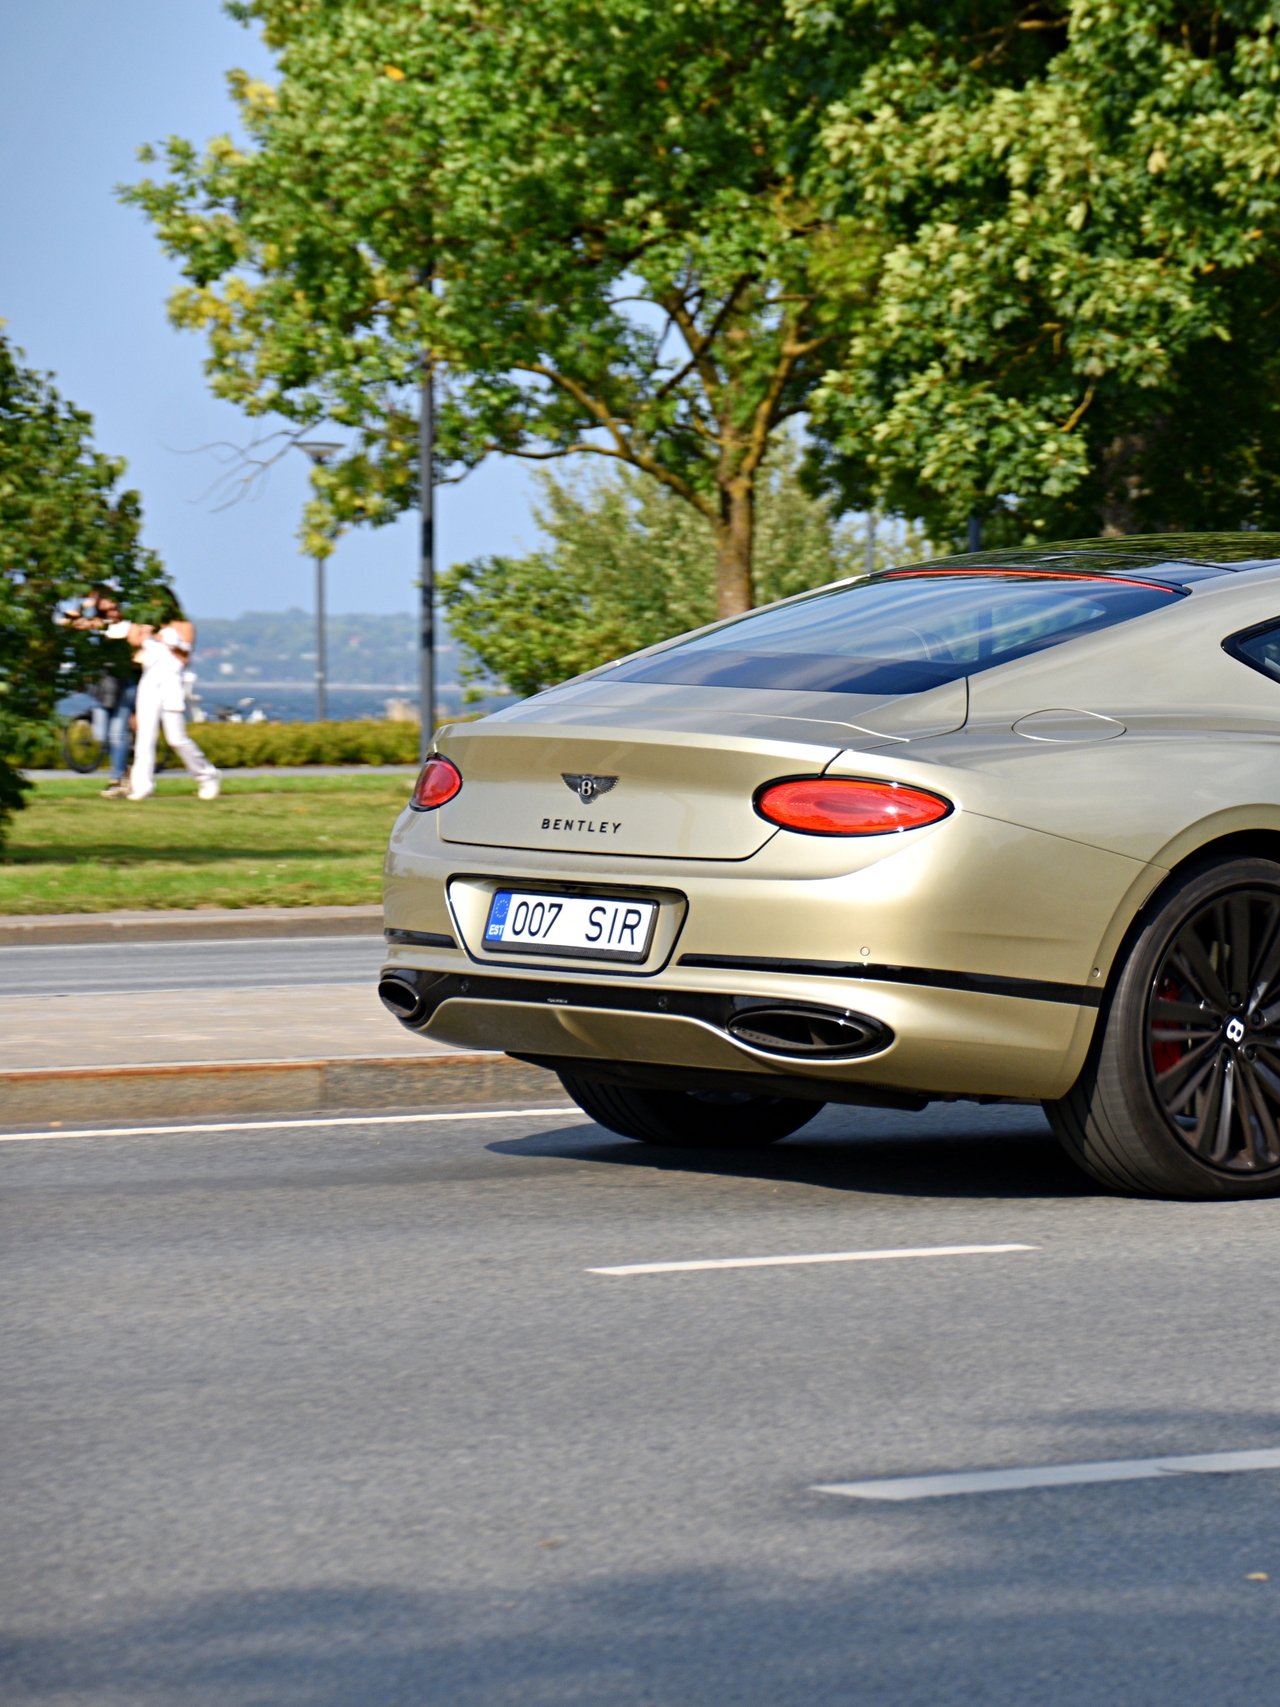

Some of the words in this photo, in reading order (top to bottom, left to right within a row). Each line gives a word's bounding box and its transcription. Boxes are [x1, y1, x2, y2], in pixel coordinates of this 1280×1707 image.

[541, 817, 622, 834] BENTLEY
[489, 924, 505, 936] EST
[511, 900, 564, 939] 007
[585, 906, 642, 946] SIR
